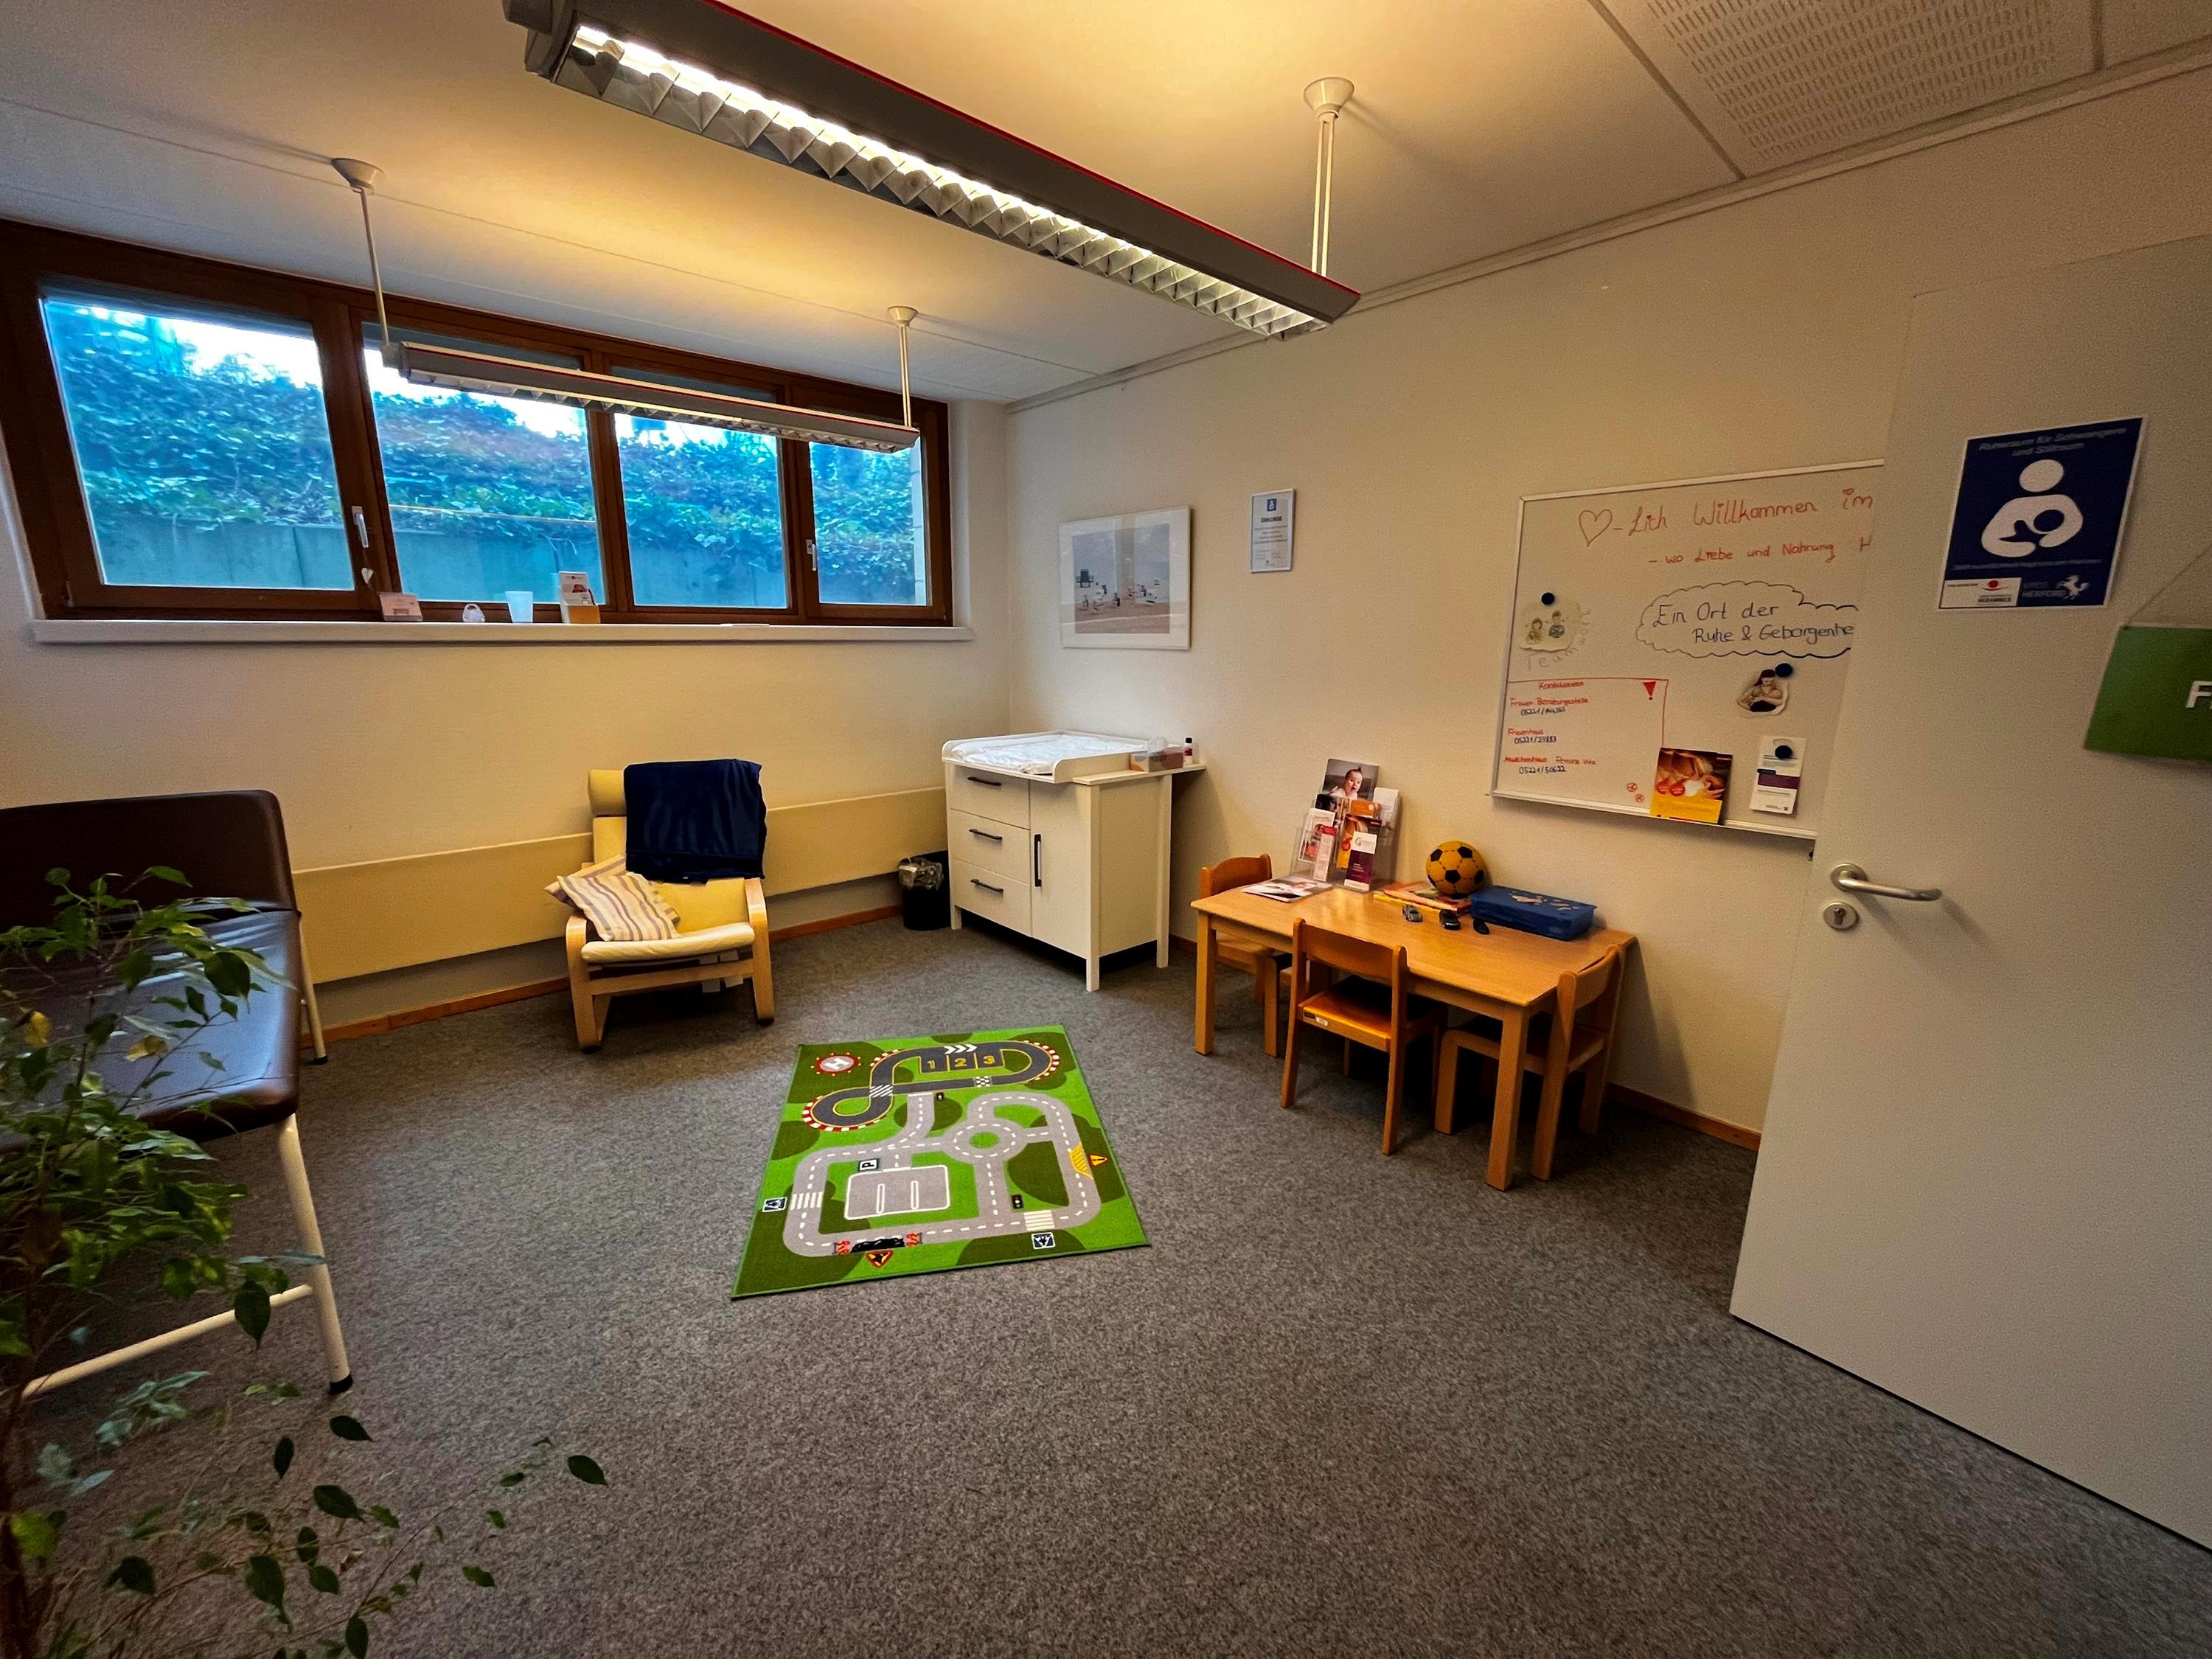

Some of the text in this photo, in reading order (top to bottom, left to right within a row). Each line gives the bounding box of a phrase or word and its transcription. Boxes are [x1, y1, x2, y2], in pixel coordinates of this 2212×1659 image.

[1694, 499, 1817, 526] Willkommen
[1843, 488, 1874, 510] im
[1665, 554, 1684, 564] wo
[1694, 548, 1733, 563] Liebe
[1747, 545, 1771, 557] und
[1781, 542, 1836, 563] Nahrung
[1653, 602, 1780, 627] Ein Ort der
[1692, 627, 1733, 644] Ruhe
[1742, 625, 1753, 641] &
[2185, 680, 2212, 709] F
[927, 1055, 995, 1069] 1 2 3
